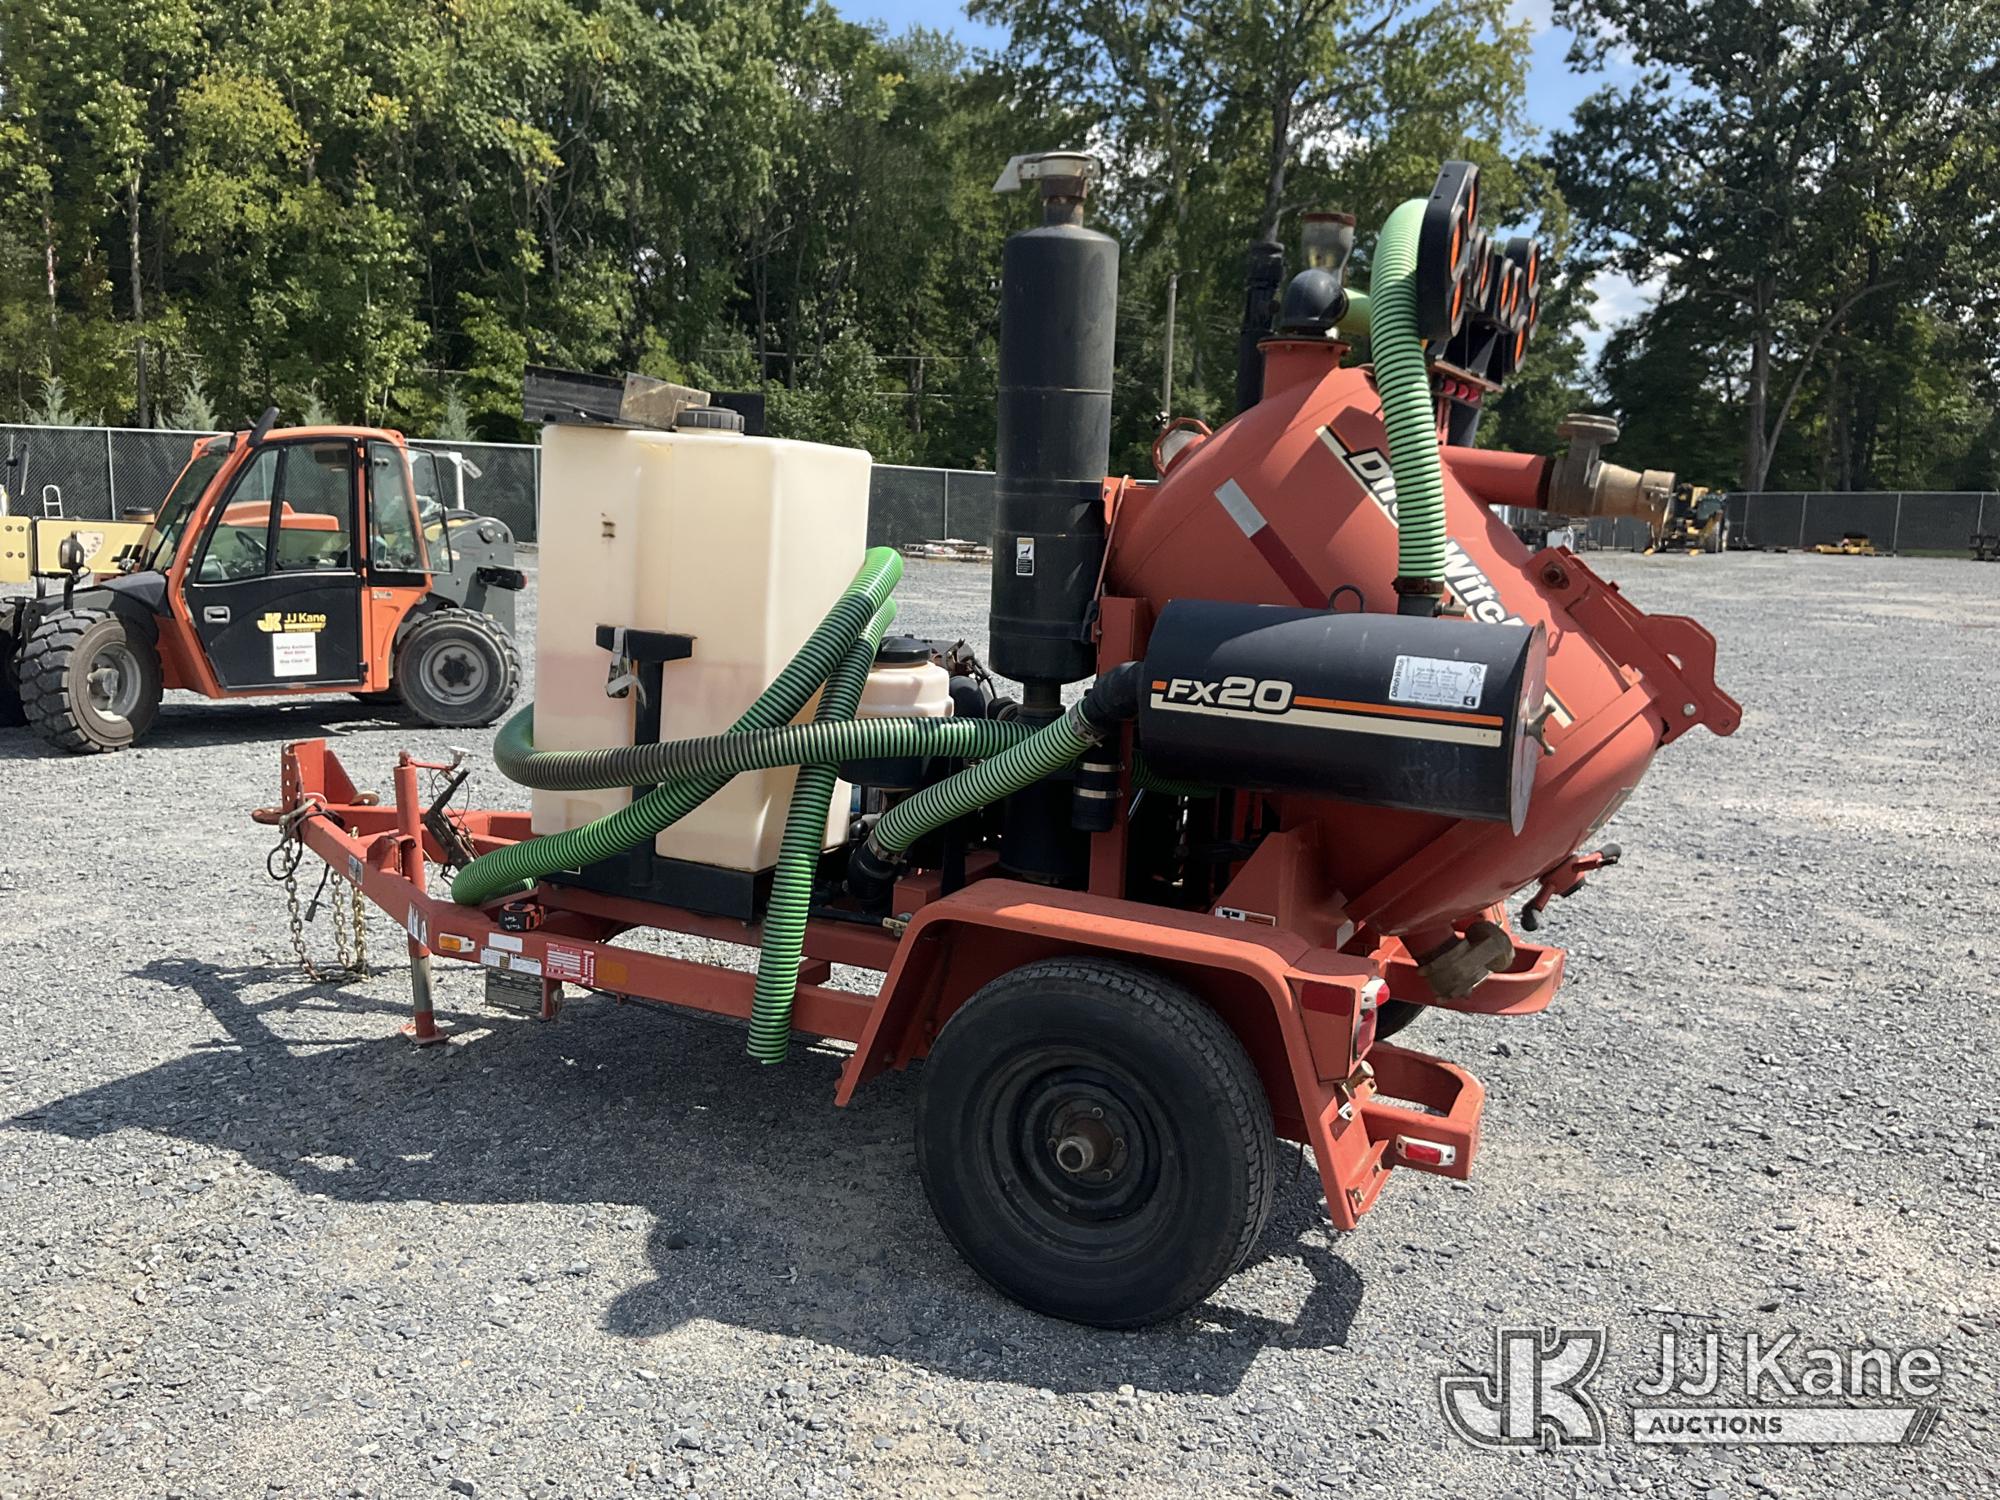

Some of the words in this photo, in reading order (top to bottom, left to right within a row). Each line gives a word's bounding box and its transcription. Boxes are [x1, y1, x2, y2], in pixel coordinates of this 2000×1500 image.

[284, 612, 297, 623] JJ
[299, 612, 327, 623] Kane
[1167, 676, 1293, 711] FX20
